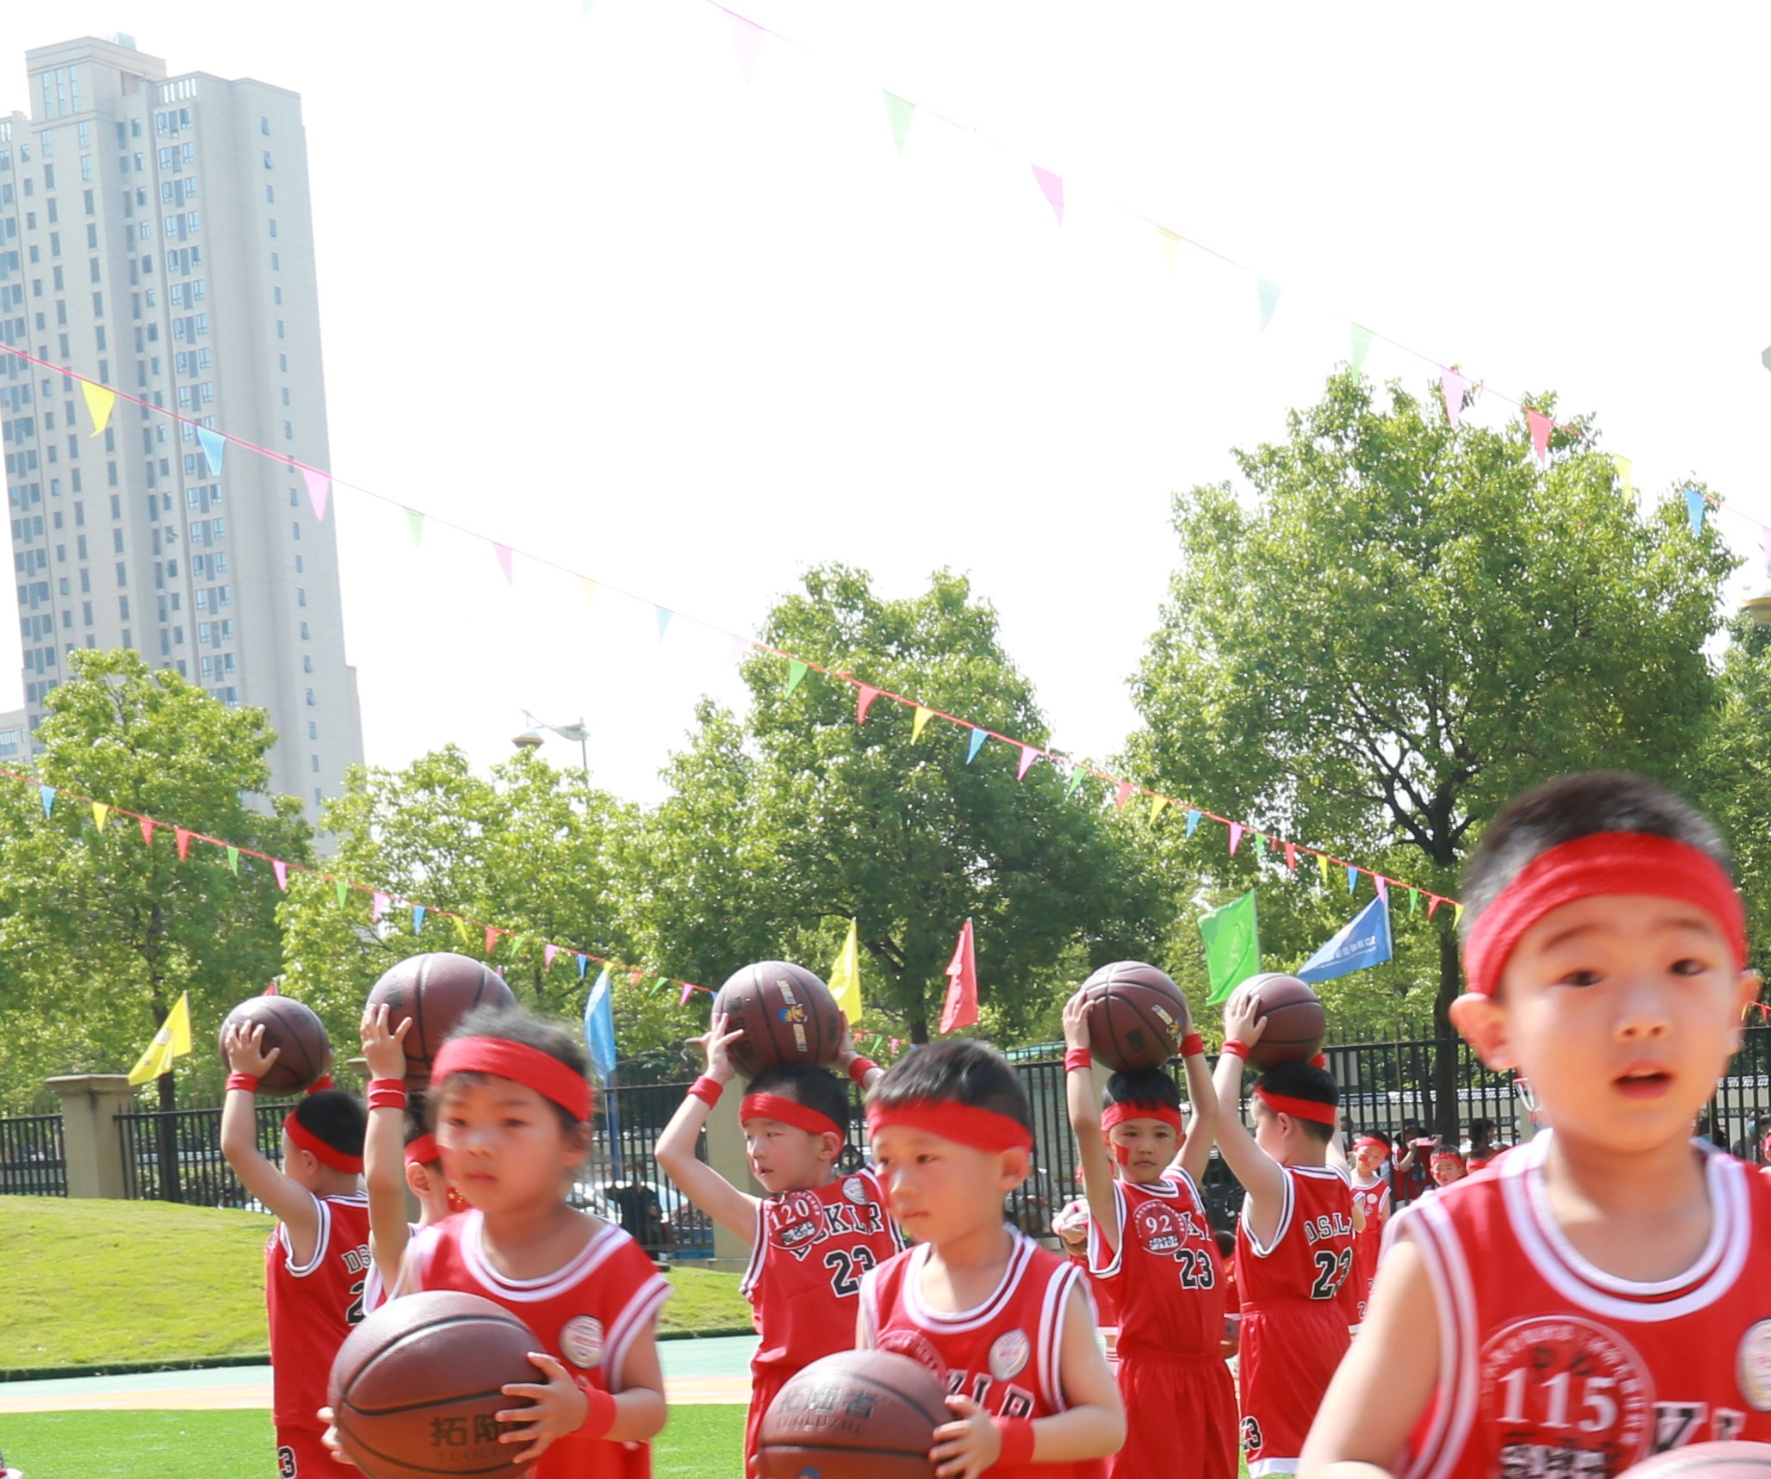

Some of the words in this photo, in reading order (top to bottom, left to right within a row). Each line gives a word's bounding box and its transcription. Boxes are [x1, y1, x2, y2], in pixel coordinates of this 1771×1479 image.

[769, 1199, 810, 1231] 120
[1145, 1214, 1173, 1234] 92
[1174, 1247, 1215, 1290] 23
[1496, 1367, 1619, 1433] 115
